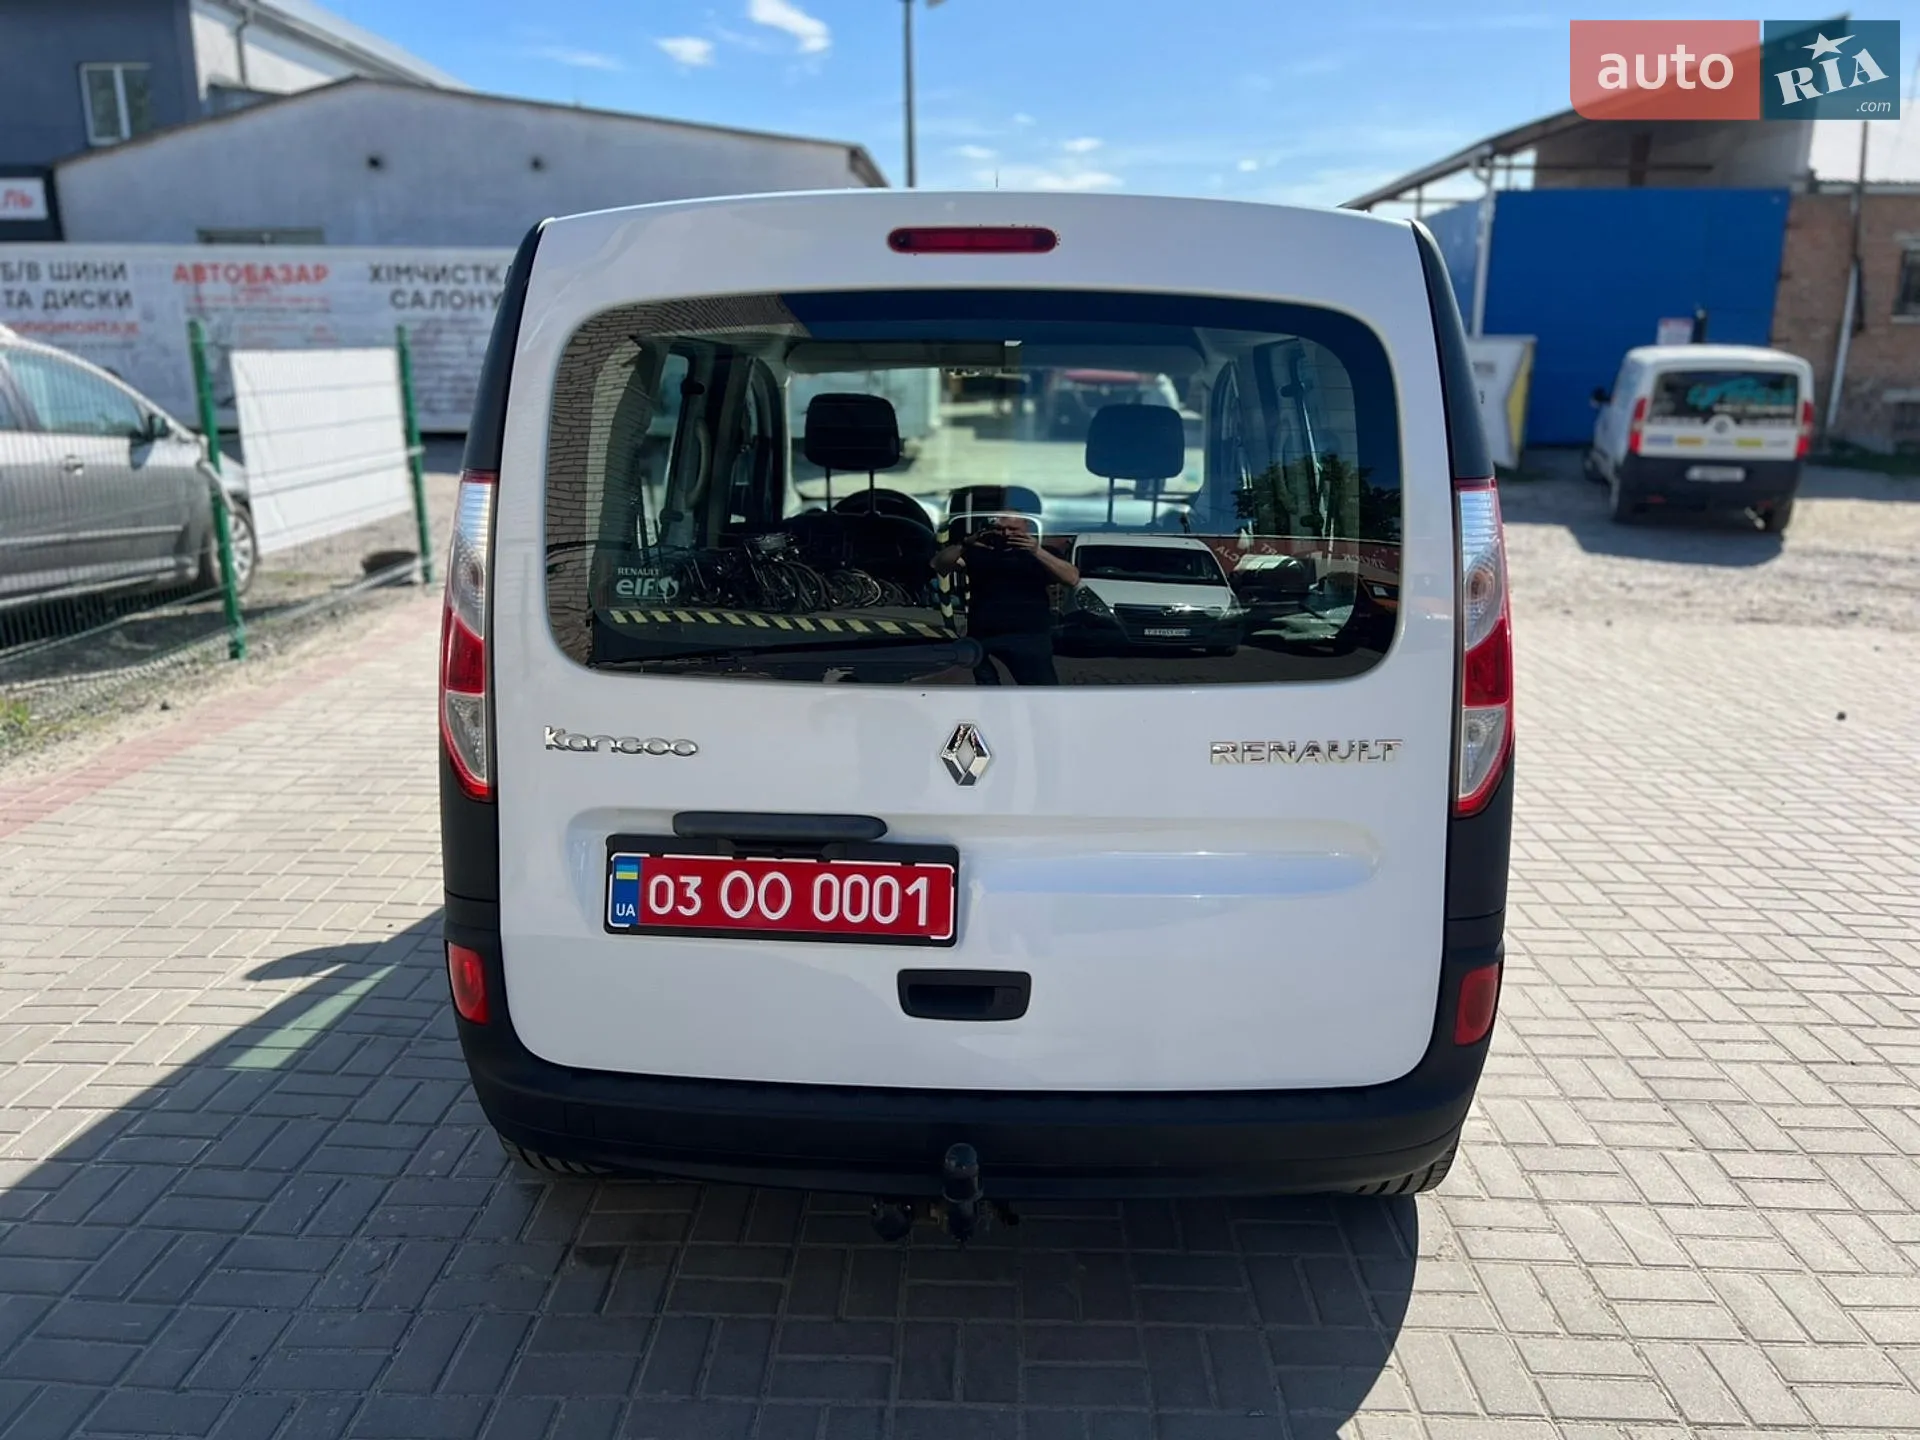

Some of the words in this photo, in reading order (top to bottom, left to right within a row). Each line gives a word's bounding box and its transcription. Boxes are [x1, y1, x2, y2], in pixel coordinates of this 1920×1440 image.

[48, 261, 128, 282] ШИНИ
[172, 261, 330, 284] АВТОБАЗАР
[4, 289, 34, 309] ТА
[42, 288, 134, 311] ДИСКИ
[617, 567, 659, 576] RENAULT
[616, 577, 655, 596] elf
[544, 725, 700, 758] Kangoo
[1209, 738, 1404, 765] RENAULT
[616, 903, 636, 917] UA
[648, 874, 703, 917] 03
[812, 872, 930, 927] 0001
